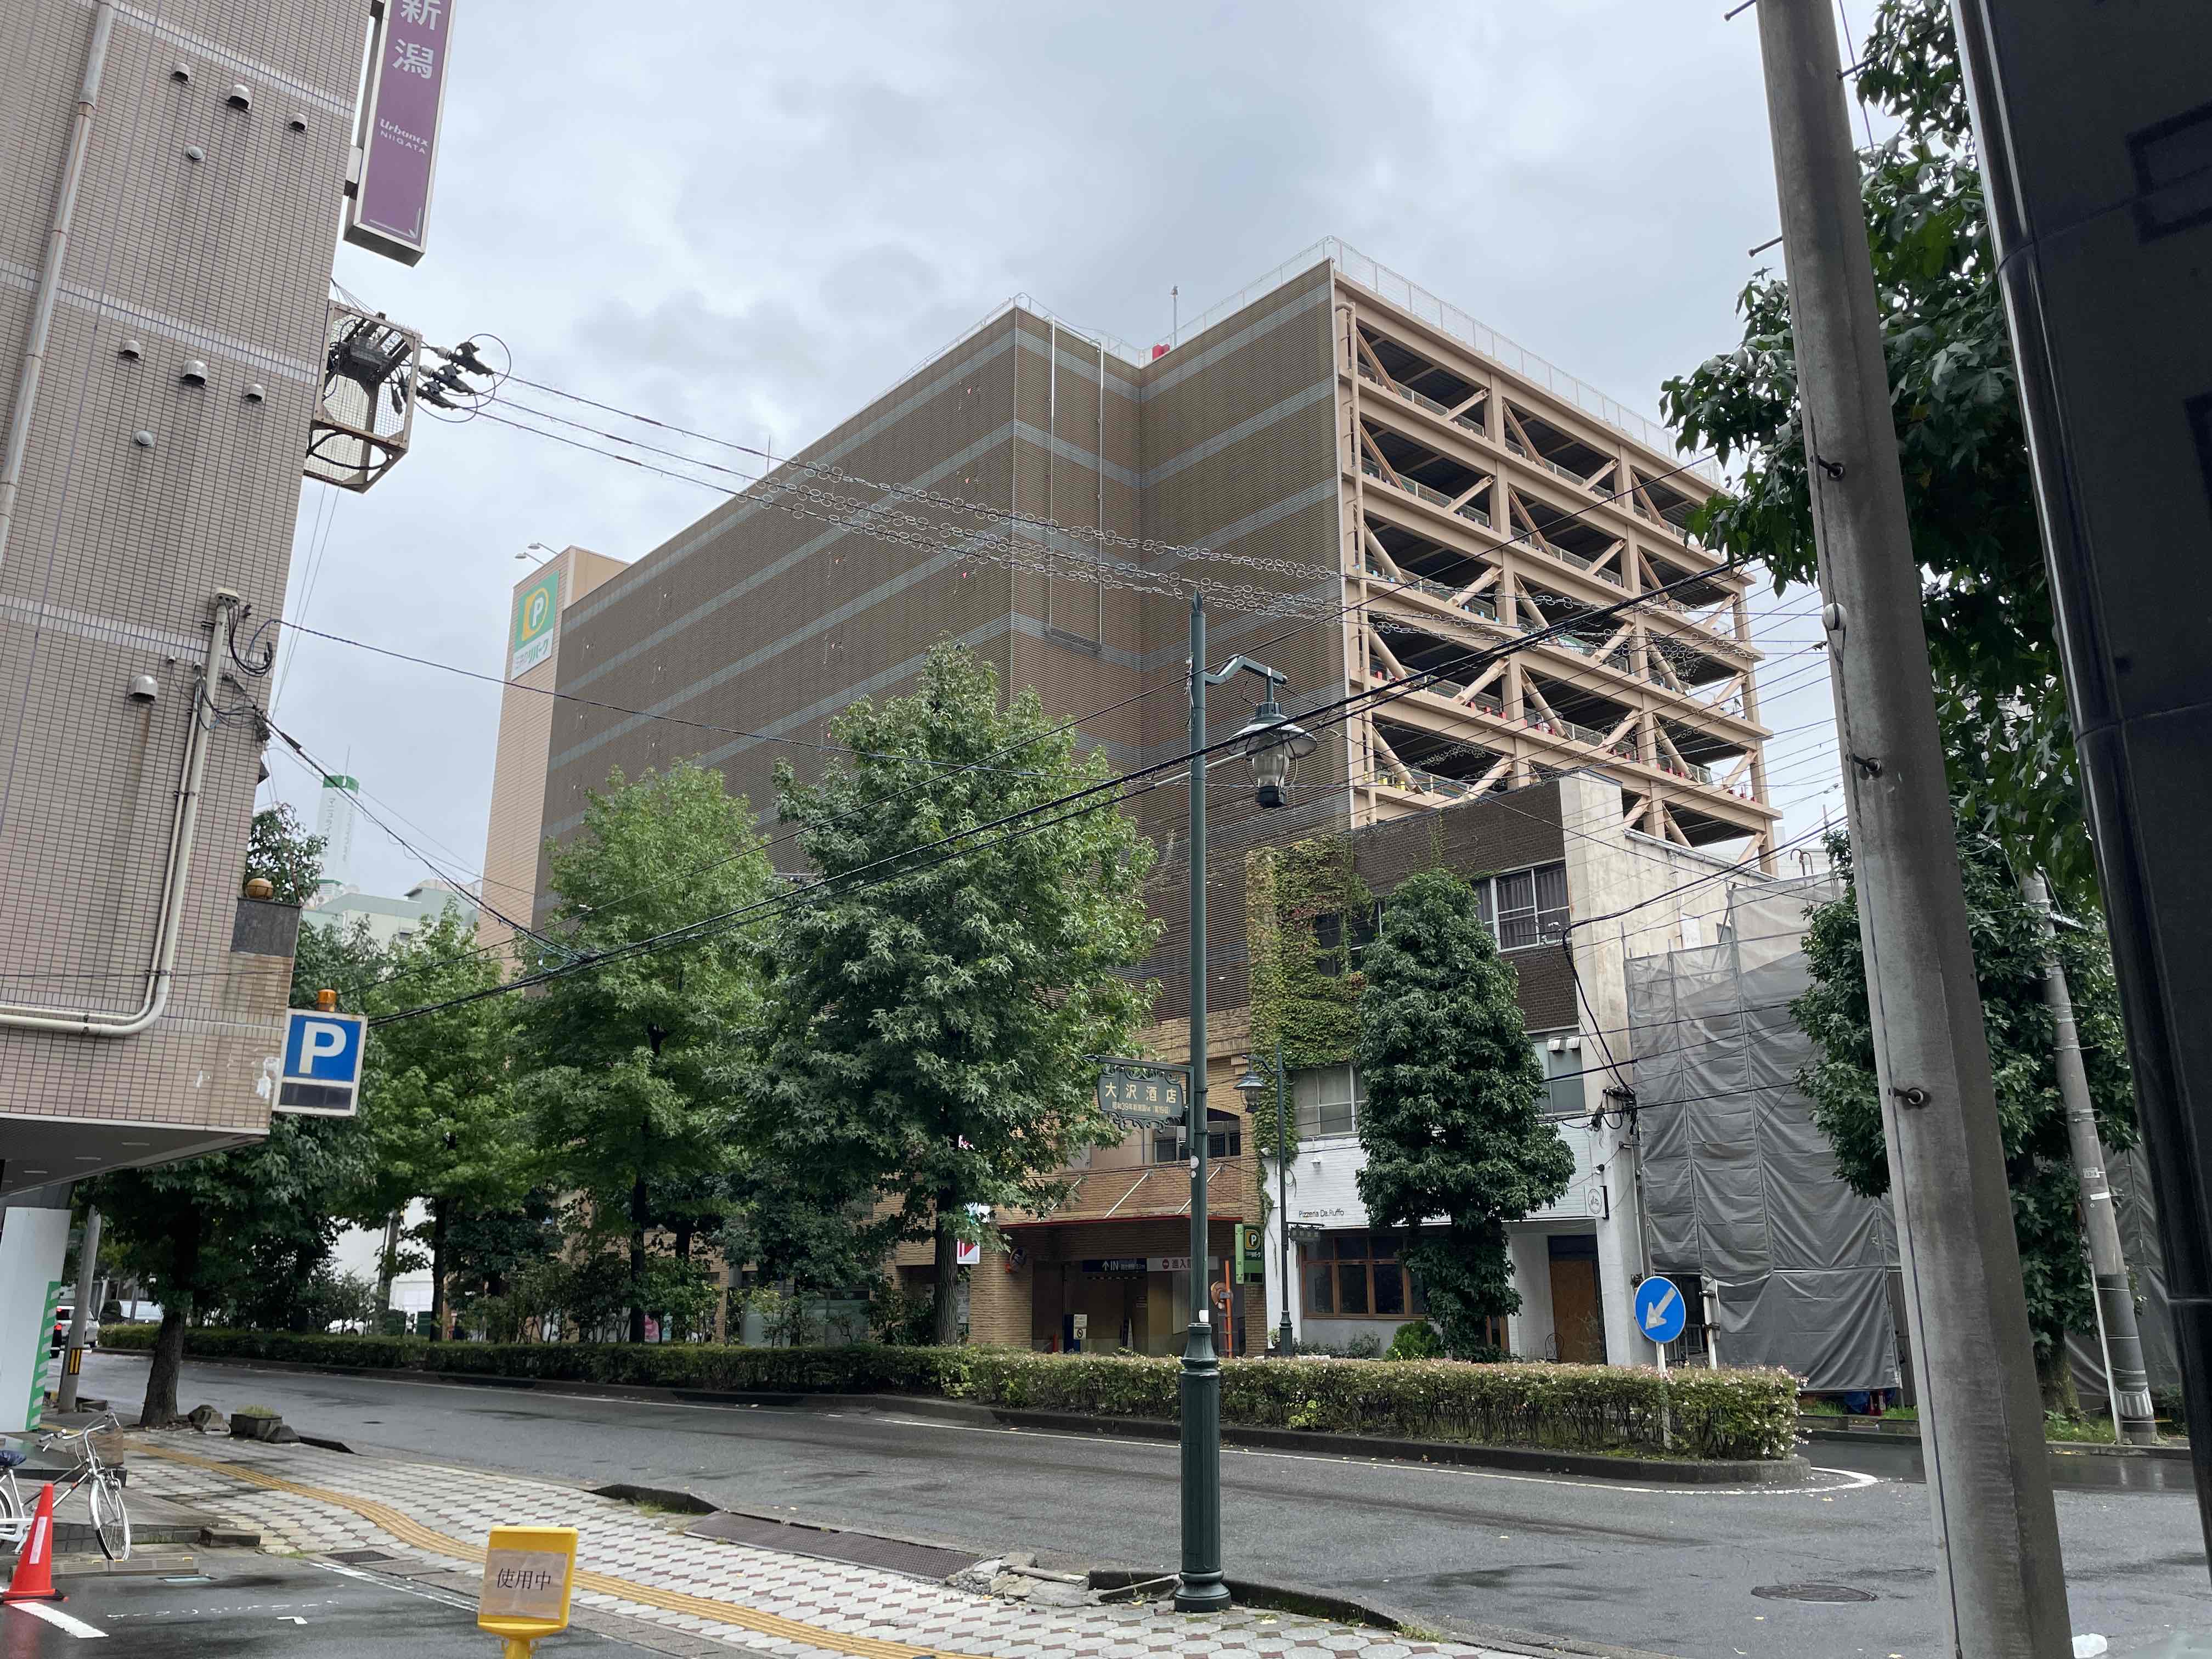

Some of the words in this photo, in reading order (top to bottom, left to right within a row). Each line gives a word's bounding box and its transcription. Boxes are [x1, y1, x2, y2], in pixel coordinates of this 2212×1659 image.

[392, 0, 442, 79] 新潟
[381, 130, 426, 154] NIIGATA
[532, 596, 544, 627] P
[298, 1021, 346, 1074] P
[1105, 1082, 1176, 1103] 大沢酒店
[1251, 1234, 1257, 1245] P
[1110, 1260, 1119, 1271] IN
[497, 1568, 551, 1590] 使用中
